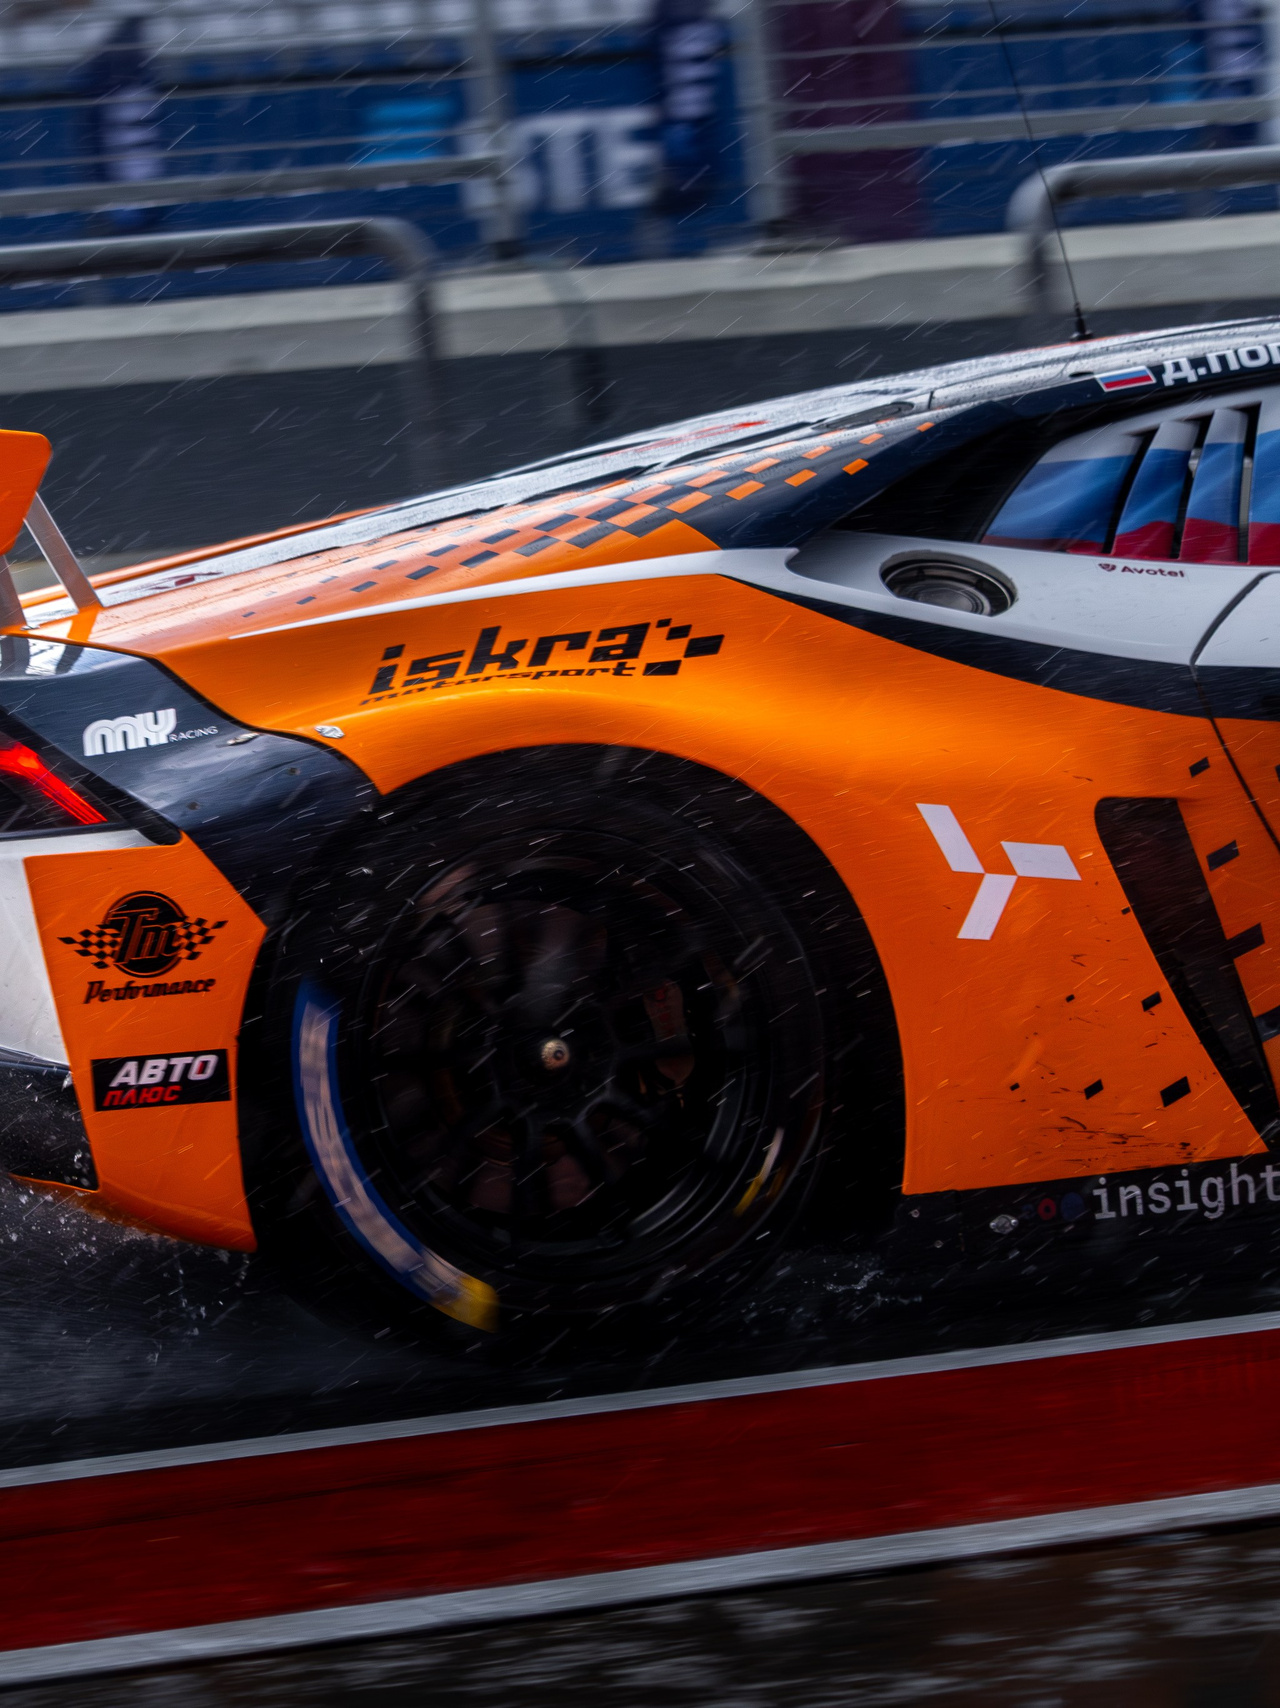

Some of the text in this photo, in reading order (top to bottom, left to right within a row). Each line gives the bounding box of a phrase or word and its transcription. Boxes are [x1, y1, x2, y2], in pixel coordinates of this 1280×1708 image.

[1121, 565, 1185, 578] Avotel
[368, 622, 651, 695] iskra
[360, 661, 636, 706] motorsport
[170, 725, 219, 743] RACING
[83, 978, 217, 1004] Performance
[109, 1054, 218, 1088] АВТО
[102, 1085, 182, 1107] ПЛЮС
[1092, 1162, 1280, 1221] insight
